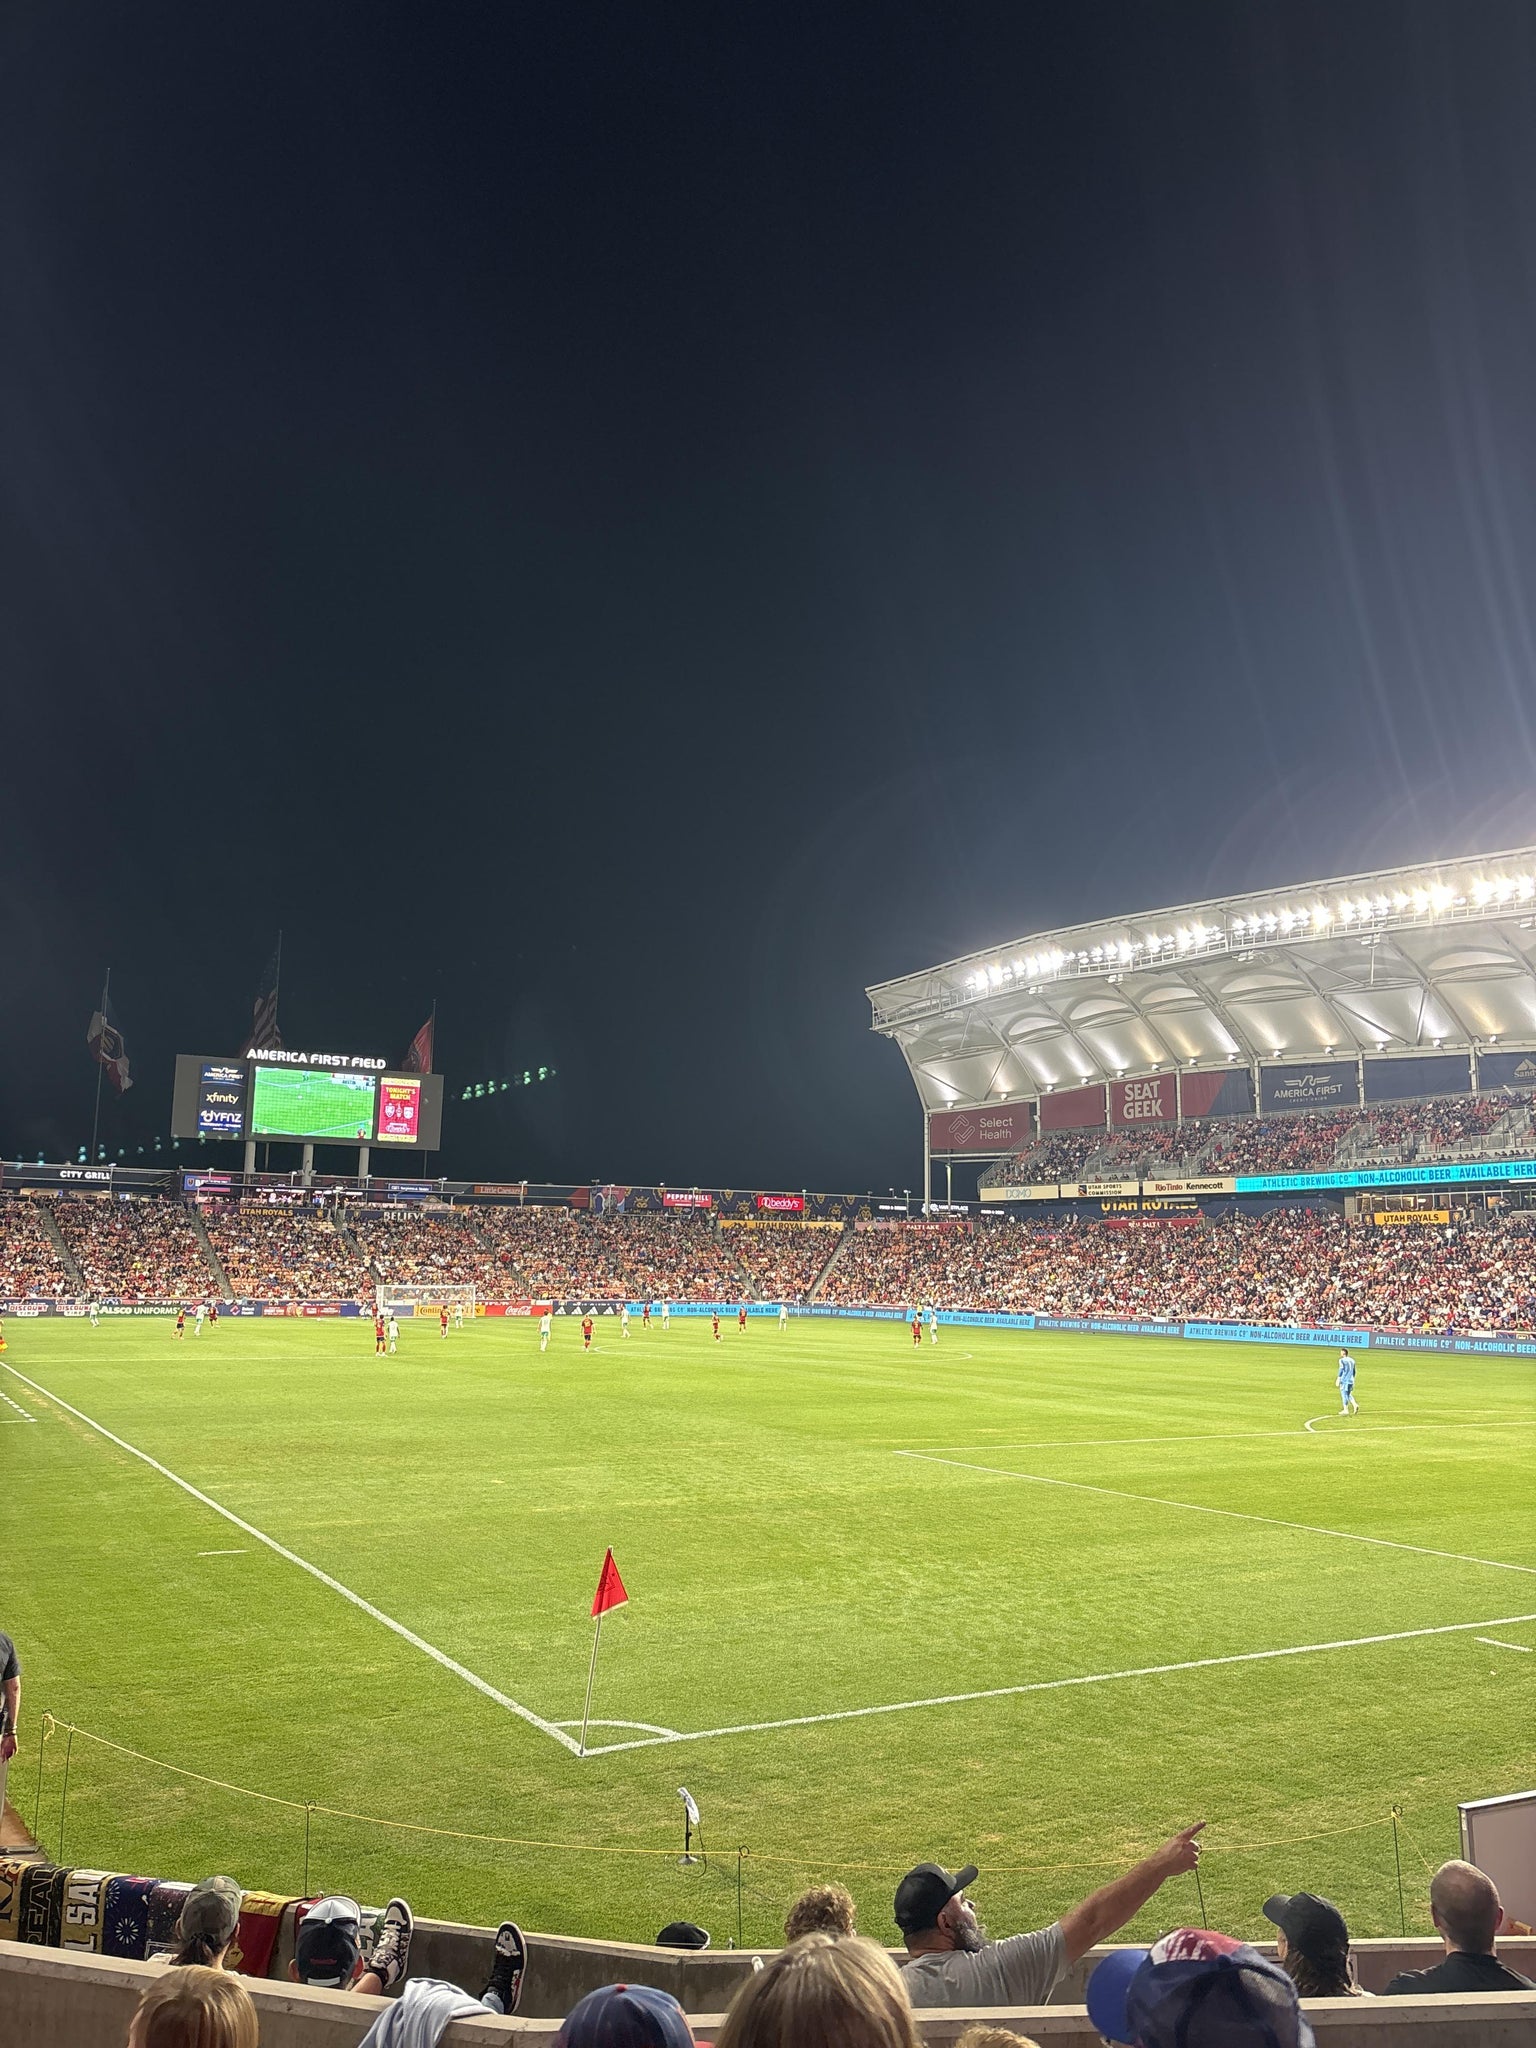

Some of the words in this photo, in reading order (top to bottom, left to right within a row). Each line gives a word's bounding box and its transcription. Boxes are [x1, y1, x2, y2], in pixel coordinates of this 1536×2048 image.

[246, 1048, 308, 1064] AMERICA
[310, 1053, 350, 1067] FIRST
[351, 1055, 387, 1070] FIELD
[1513, 1069, 1536, 1079] Sand
[385, 1087, 416, 1095] TONIGHT'S
[1124, 1080, 1161, 1101] SEAT
[1273, 1087, 1315, 1099] AMERICA
[1315, 1083, 1343, 1097] FIRST
[206, 1092, 239, 1105] xfinity
[1122, 1099, 1163, 1120] GEEK
[979, 1116, 1013, 1128] Select
[979, 1129, 1012, 1140] Health
[59, 1170, 83, 1179] CITY
[84, 1171, 111, 1180] GRILL
[1262, 1176, 1298, 1189] ATHLETIC
[1301, 1175, 1336, 1187] BREWING
[1357, 1168, 1426, 1185] NON-ALCOHOLIC
[1428, 1167, 1451, 1181] BEER
[1459, 1164, 1511, 1179] AVAILABLE
[480, 1186, 497, 1195] Little
[1186, 1181, 1224, 1191] Kennecott
[666, 1193, 709, 1202] PEPPERMILL
[1006, 1188, 1032, 1199] DOMO
[769, 1198, 800, 1209] beddy's
[1101, 1199, 1138, 1211] UTAH
[239, 1208, 262, 1216] UTAH
[263, 1208, 294, 1217] ROYALS
[1384, 1214, 1405, 1223] UTAH
[1406, 1213, 1440, 1223] ROYALS
[755, 1222, 778, 1230] UTAH
[99, 1305, 133, 1315] ALSCO
[1038, 1319, 1059, 1327] ATHLETIC
[1189, 1327, 1213, 1336] ATHLETIC
[1214, 1328, 1237, 1337] BREWING
[1249, 1329, 1295, 1341] NON-ALCOHOLIC
[1295, 1331, 1311, 1341] BEER
[1313, 1332, 1346, 1343] AVAILABLE
[1346, 1334, 1362, 1344] HERE
[1375, 1336, 1405, 1346] ATHLETIC
[1407, 1338, 1438, 1348] BREWING
[1455, 1341, 1515, 1353] NON-ALCOHOLIC
[1516, 1344, 1536, 1354] BEER
